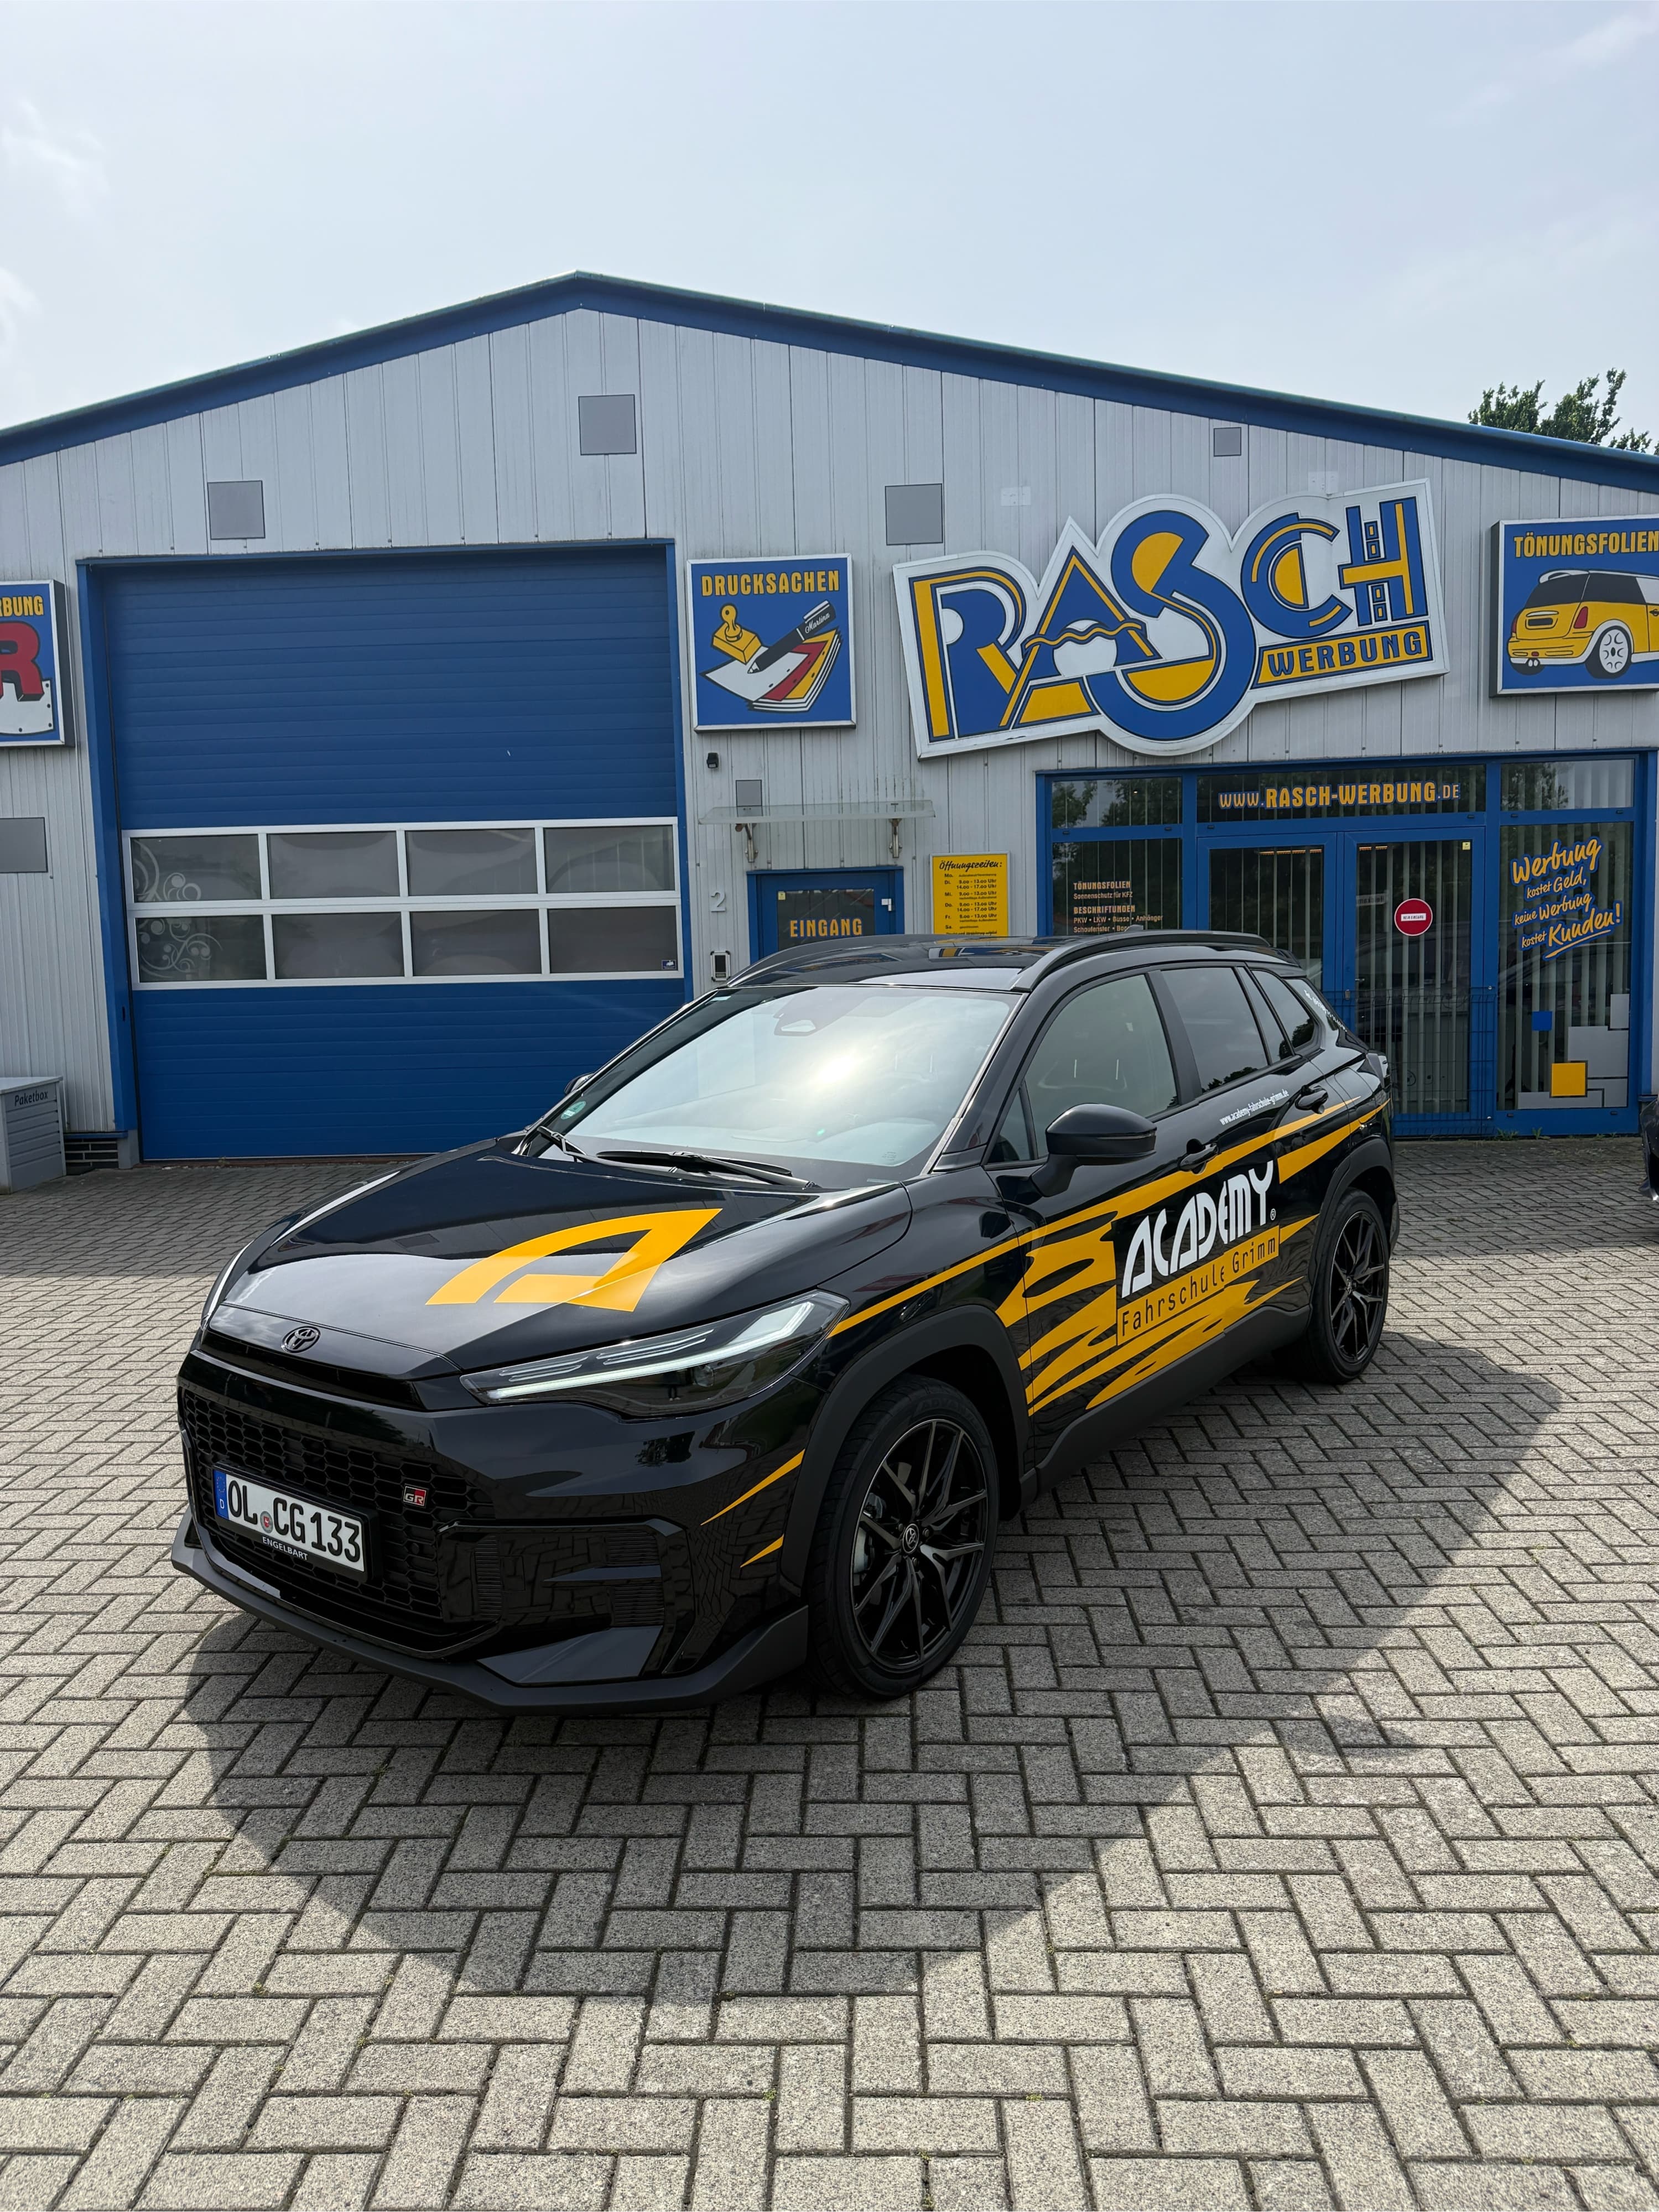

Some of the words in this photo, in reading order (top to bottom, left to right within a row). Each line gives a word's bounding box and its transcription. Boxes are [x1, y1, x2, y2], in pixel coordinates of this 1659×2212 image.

[1514, 532, 1659, 558] TÖNUNGSFOLIEN
[701, 570, 840, 596] DRUCKSACHEN
[0, 596, 44, 617] BUNG
[908, 496, 1428, 743] RASCH
[805, 613, 830, 633] Martina
[1267, 631, 1422, 678] WERBUNG
[1219, 782, 1459, 808] www.RASCH-WERBUNG.DE
[939, 860, 1002, 872] Öffnungszeiten:
[1513, 839, 1601, 884] Werbung
[1527, 882, 1552, 898] kostet
[1553, 866, 1587, 893] Geld,
[710, 890, 726, 913] 2
[1515, 911, 1537, 925] keine
[1539, 893, 1593, 920] Werbung
[790, 918, 862, 938] EINGANG
[1522, 931, 1547, 948] kostet
[1549, 903, 1620, 946] Kunden!
[14, 1090, 48, 1106] Paketbox
[1219, 1089, 1289, 1126] www.academy-fahrschule-grimm.de
[1122, 1265, 1225, 1336] Fahrschule
[1232, 1237, 1276, 1273] Grimm
[220, 1498, 225, 1510] D
[228, 1480, 258, 1525] OL
[404, 1492, 424, 1506] GR
[262, 1536, 308, 1561] ENGELBART
